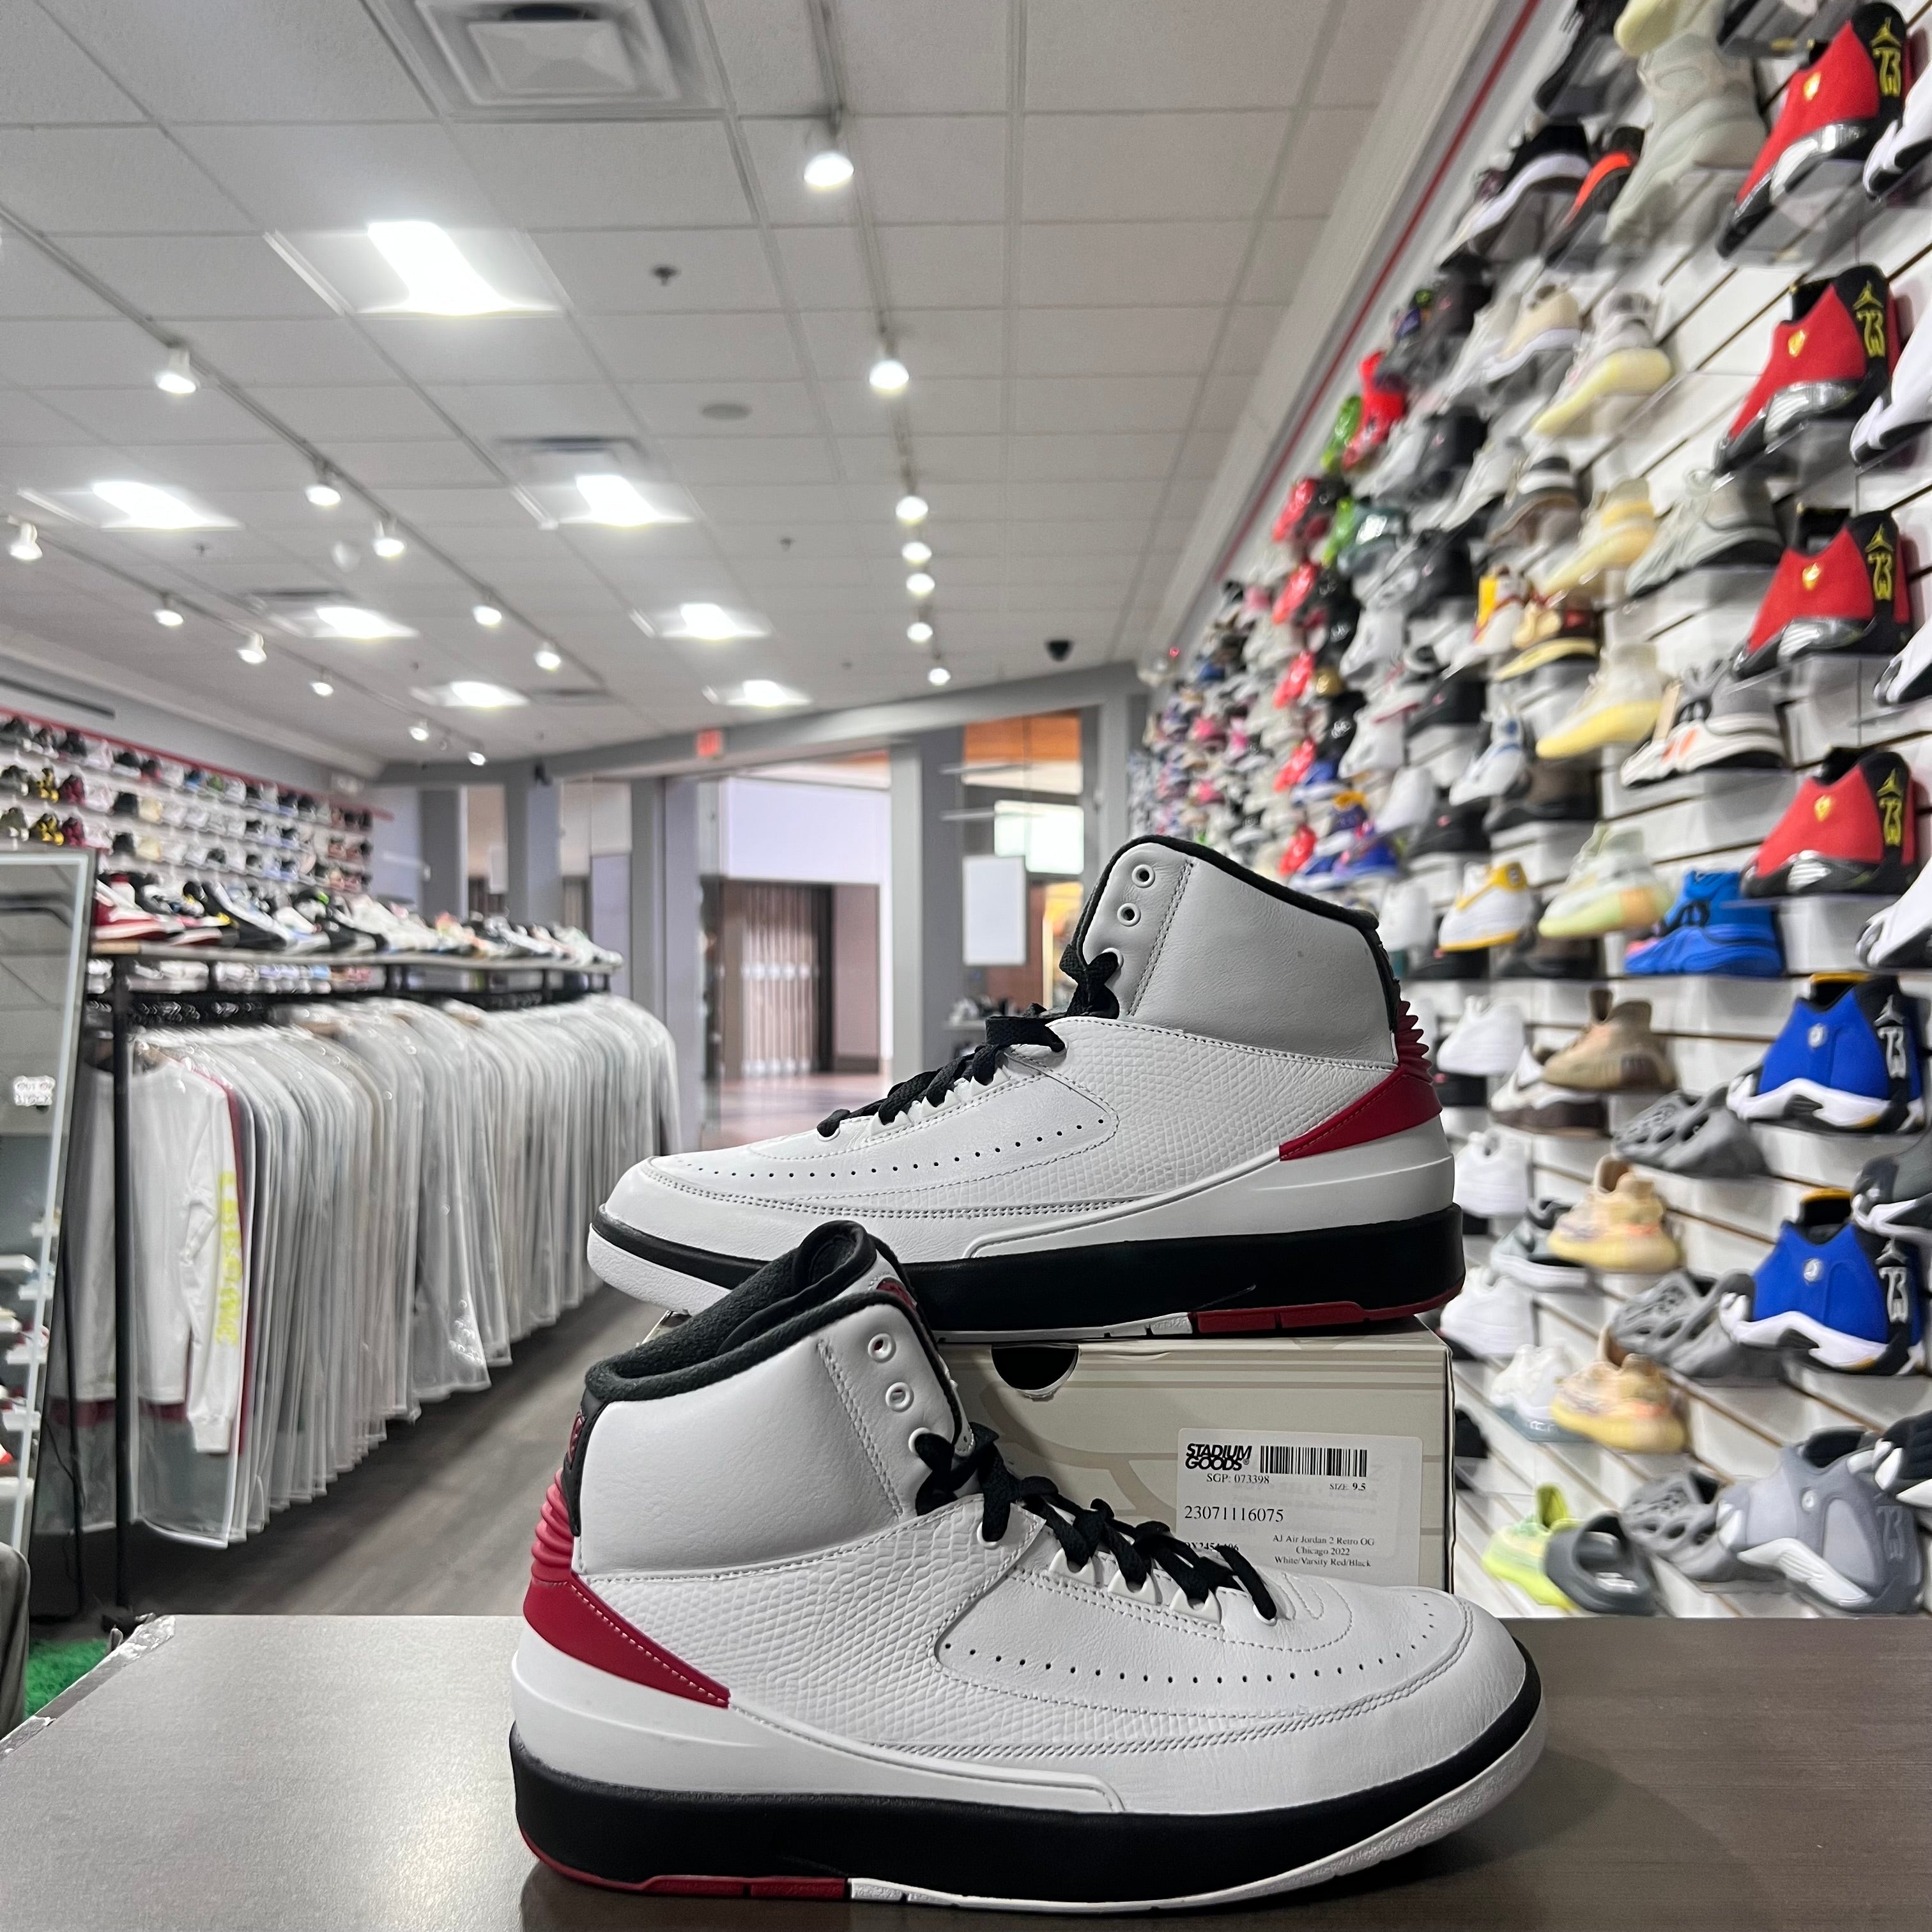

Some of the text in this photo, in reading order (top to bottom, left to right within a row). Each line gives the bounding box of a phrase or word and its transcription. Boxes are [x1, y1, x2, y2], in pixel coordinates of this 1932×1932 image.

[1186, 1443, 1253, 1460] STADIUM
[1206, 1473, 1269, 1483] SGP: 073398
[1353, 1482, 1366, 1491] 9.5
[1184, 1505, 1284, 1522] 23071116075
[1301, 1536, 1327, 1544] Jordan
[1337, 1537, 1358, 1545] Retro
[1360, 1538, 1374, 1546] OG
[1296, 1546, 1350, 1556] Chicago 2022
[1275, 1556, 1371, 1567] White/Varsity Red/Black
